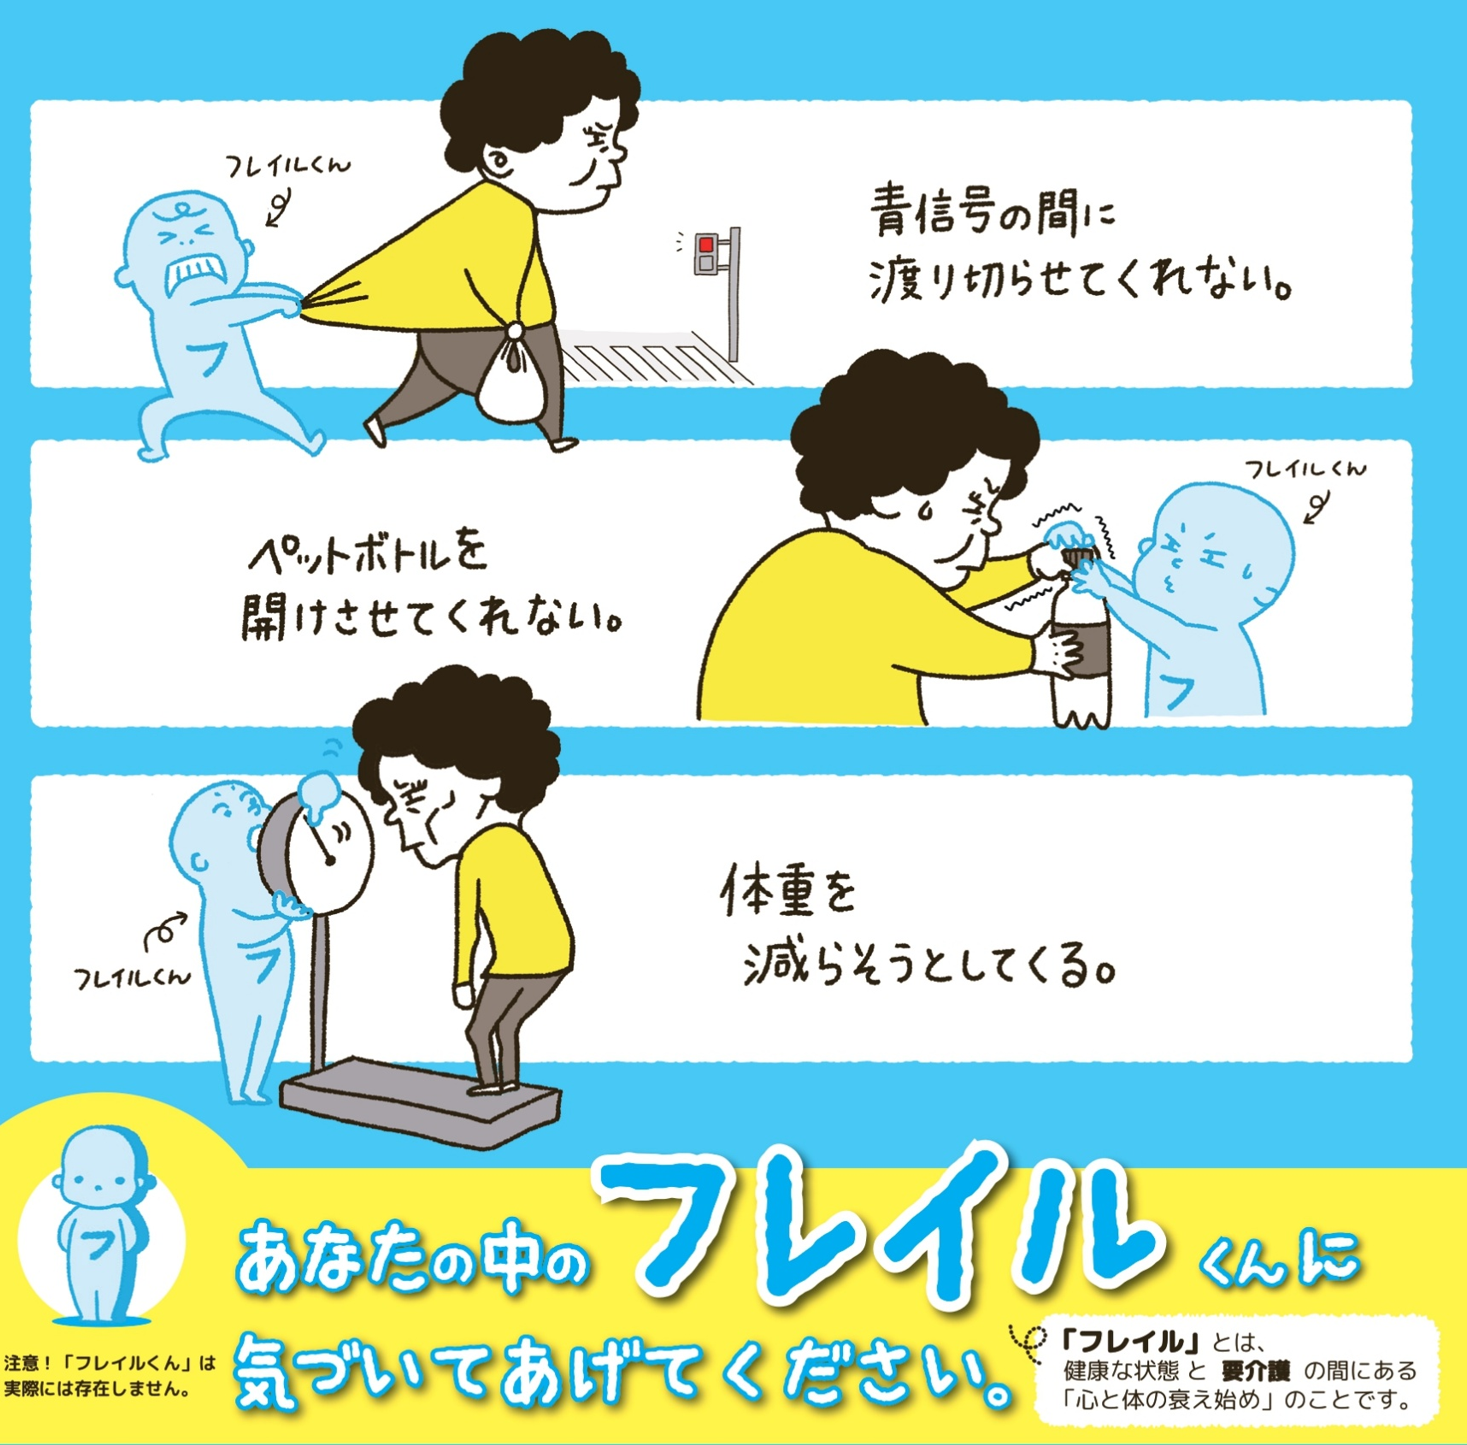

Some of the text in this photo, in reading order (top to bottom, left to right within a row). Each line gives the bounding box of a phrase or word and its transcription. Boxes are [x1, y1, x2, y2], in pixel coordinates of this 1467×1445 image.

[225, 154, 352, 178] フレイルくん
[870, 179, 1116, 238] 青信号の間に
[869, 253, 1292, 305] 渡り切らせてくれない。
[1245, 459, 1367, 480] フレイルくん
[247, 526, 488, 576] ペットボトルを
[241, 592, 623, 642] 開けさせてくれない。
[719, 860, 855, 918] 体重を
[73, 968, 192, 991] フレイルくん
[744, 932, 1116, 989] 減らそうとしてくる。
[236, 1140, 1360, 1312] あなたの中の フレイル くんに
[4, 1354, 216, 1372] 注意！「フレイルくん」は
[233, 1332, 1012, 1413] 気づいてあげてください。
[4, 1379, 188, 1398] 実際には存在しません。
[1064, 1388, 1408, 1411] 「心と体の衰え始め」のことです。
